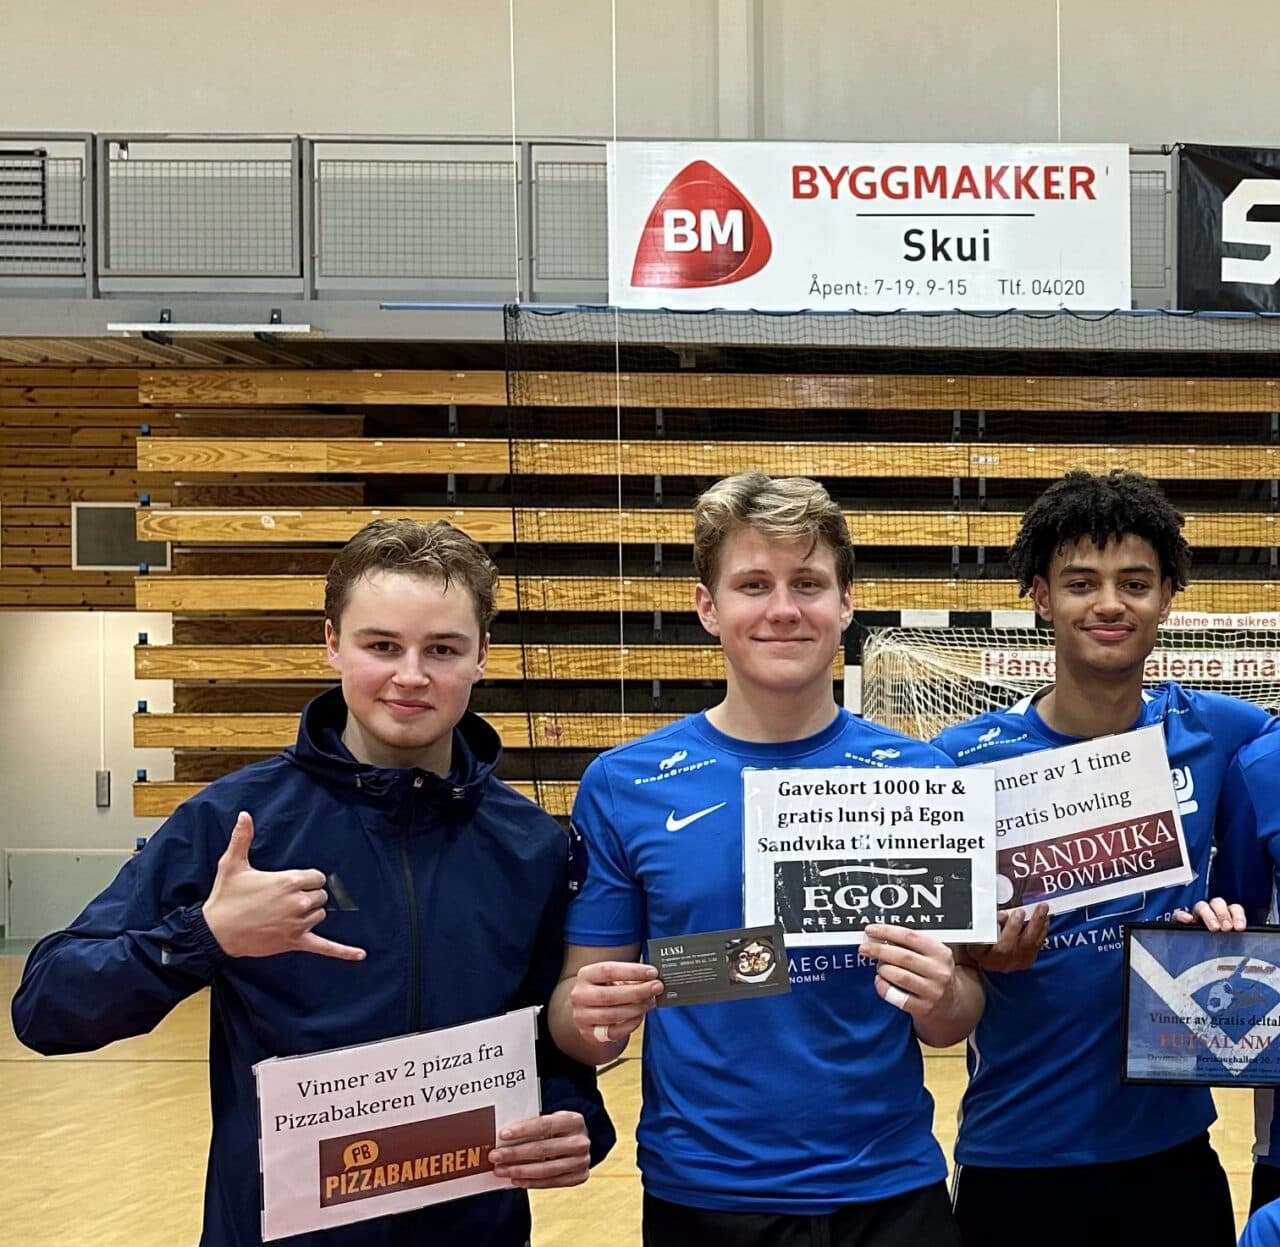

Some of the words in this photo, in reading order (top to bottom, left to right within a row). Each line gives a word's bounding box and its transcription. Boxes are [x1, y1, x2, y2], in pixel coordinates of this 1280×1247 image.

[791, 164, 1097, 201] BYGGMAKKER
[662, 208, 746, 254] BM
[903, 227, 991, 263] Skui
[808, 273, 869, 298] Åpent:
[925, 278, 968, 297] 9-15
[997, 278, 1027, 297] Tlf.
[1031, 279, 1086, 297] 04020
[1043, 764, 1066, 782] av
[1072, 758, 1083, 775] 1
[1087, 750, 1133, 772] time
[778, 779, 868, 797] Gavekort
[872, 778, 920, 796] 1000
[924, 777, 947, 796] kr
[951, 779, 966, 796] &
[777, 807, 834, 829] gratis
[838, 807, 886, 827] lunsj
[890, 806, 914, 828] på
[918, 807, 965, 827] Egon
[995, 808, 1050, 838] gratis
[1052, 790, 1133, 820] bowling
[757, 836, 846, 853] Sandvika
[876, 834, 986, 854] vinnerlaget
[1011, 818, 1176, 880] SANDVIKA
[1041, 850, 1157, 895] BOWLING
[802, 883, 945, 912] EGON
[802, 914, 946, 927] RESTAURANT
[1149, 1012, 1192, 1026] Vinner
[1193, 1015, 1208, 1026] av
[1211, 1013, 1245, 1029] gratis
[1159, 1031, 1235, 1050] FUTSAL
[1240, 1034, 1272, 1050] NM
[297, 1072, 369, 1099] Vinner
[374, 1069, 399, 1086] av
[404, 1060, 416, 1078] 2
[422, 1052, 474, 1081] pizza
[477, 1042, 505, 1062] fra
[274, 1092, 416, 1133] Pizzabakeren
[420, 1068, 527, 1104] Vøyenenga
[351, 1142, 373, 1165] PB
[324, 1147, 482, 1200] PIZZABAKEREN
